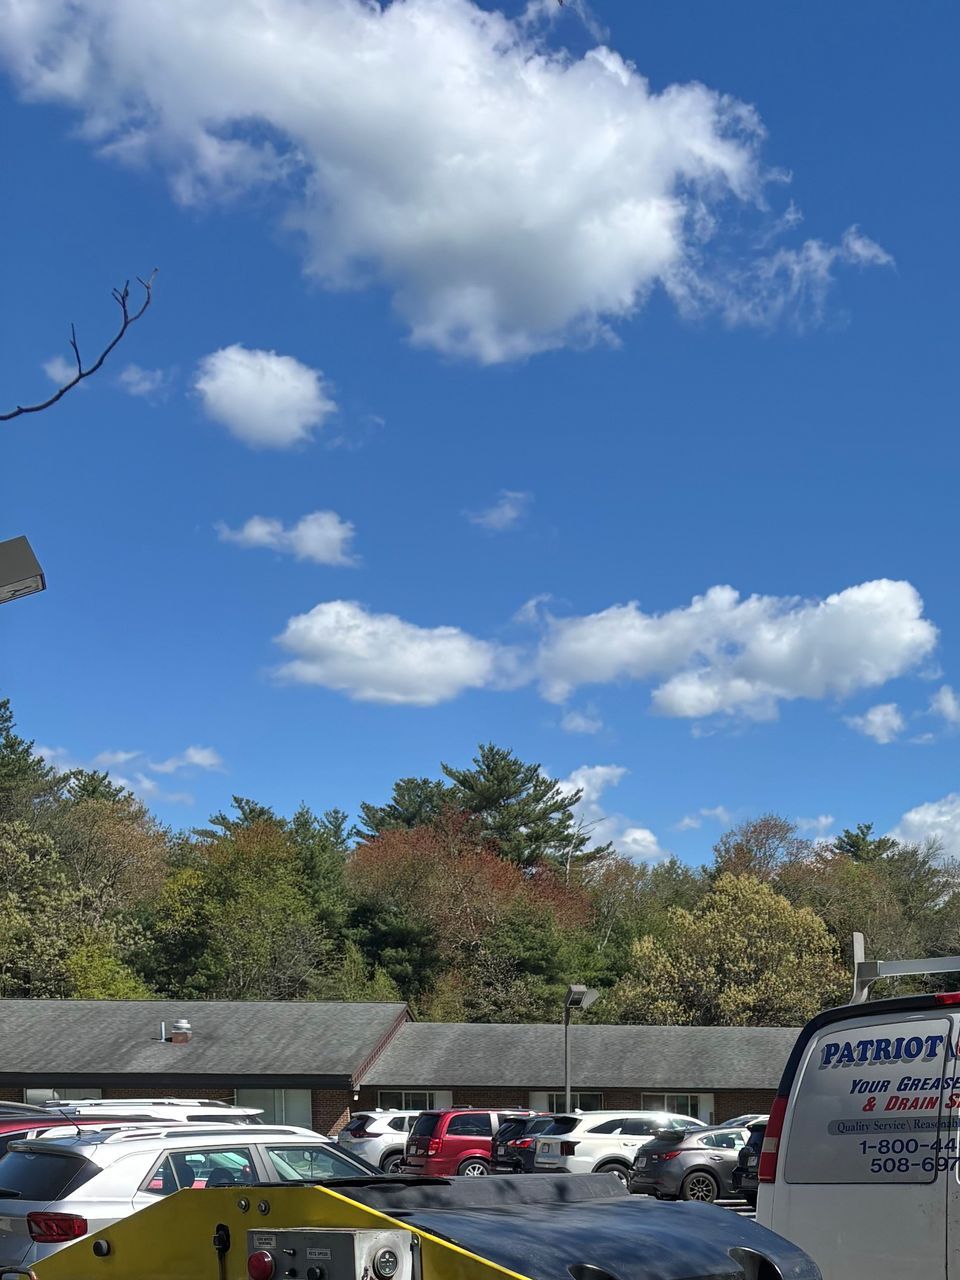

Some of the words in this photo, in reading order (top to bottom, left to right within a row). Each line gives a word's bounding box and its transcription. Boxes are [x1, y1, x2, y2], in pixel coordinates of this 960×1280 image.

[822, 1035, 944, 1066] PATRIOT
[850, 1079, 891, 1094] YOUR
[862, 1096, 877, 1112] &
[884, 1095, 940, 1111] DRAIN
[836, 1121, 871, 1134] Quality
[873, 1119, 906, 1131] Service
